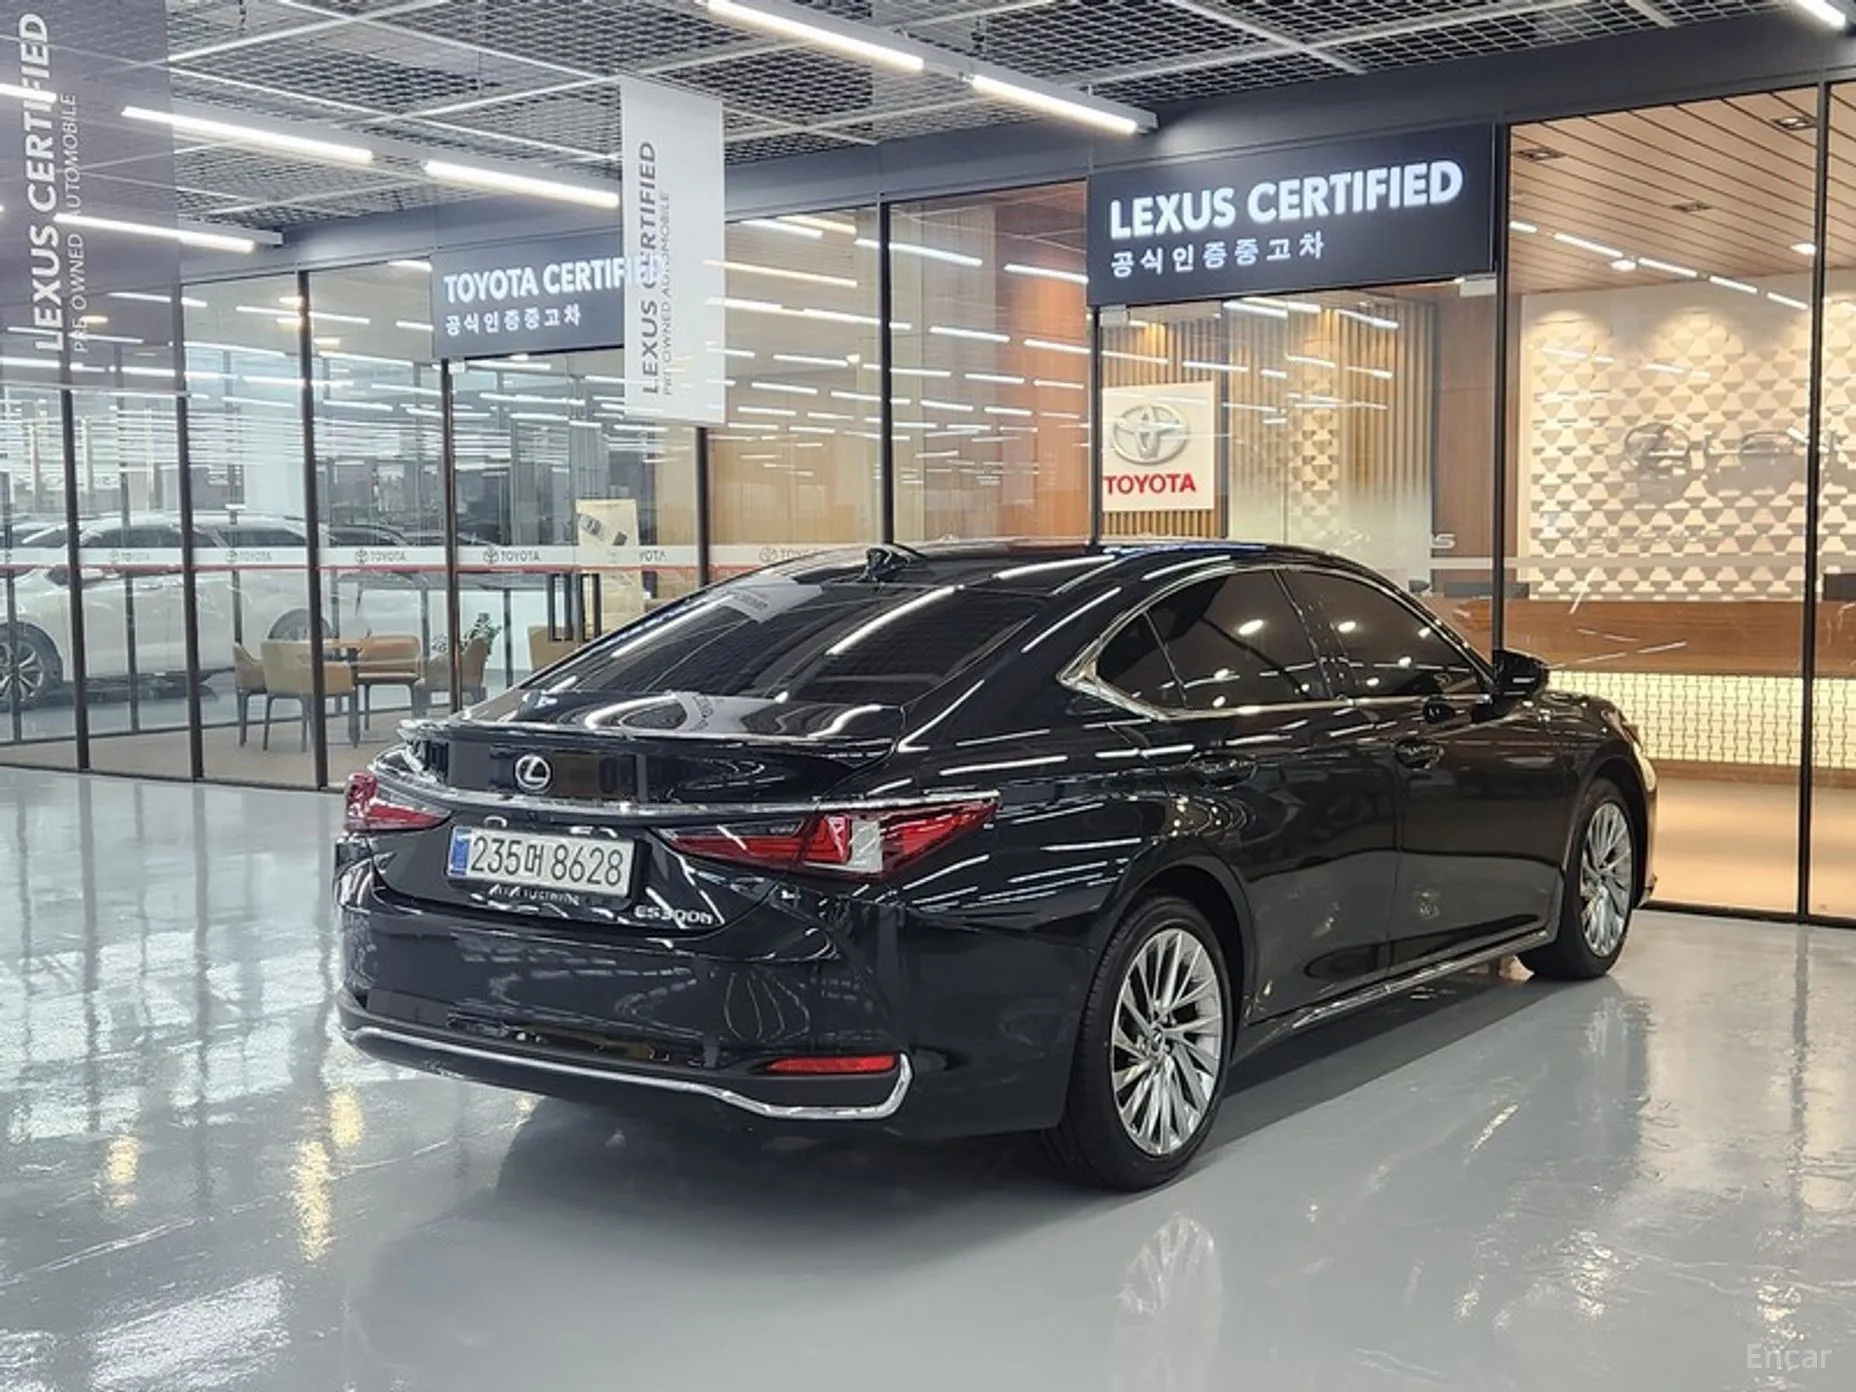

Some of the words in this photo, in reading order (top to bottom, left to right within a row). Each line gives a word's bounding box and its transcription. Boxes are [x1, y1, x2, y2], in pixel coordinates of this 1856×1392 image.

[19, 13, 57, 212] CERTIFIED
[1110, 187, 1236, 240] LEXUS
[1247, 159, 1464, 226] CERTIFIED
[67, 233, 88, 310] OWNED
[1111, 230, 1324, 279] 공식인증중고차
[30, 224, 64, 351] LEXUS
[443, 266, 539, 304] TOYOTA
[542, 256, 664, 295] CERTIF
[640, 299, 659, 394] LEXUS
[1103, 472, 1197, 495] TOYOTA
[369, 551, 408, 562] TOYOTA
[500, 550, 542, 562] TOYOTA
[471, 836, 545, 877] 235머
[551, 844, 624, 886] 8628
